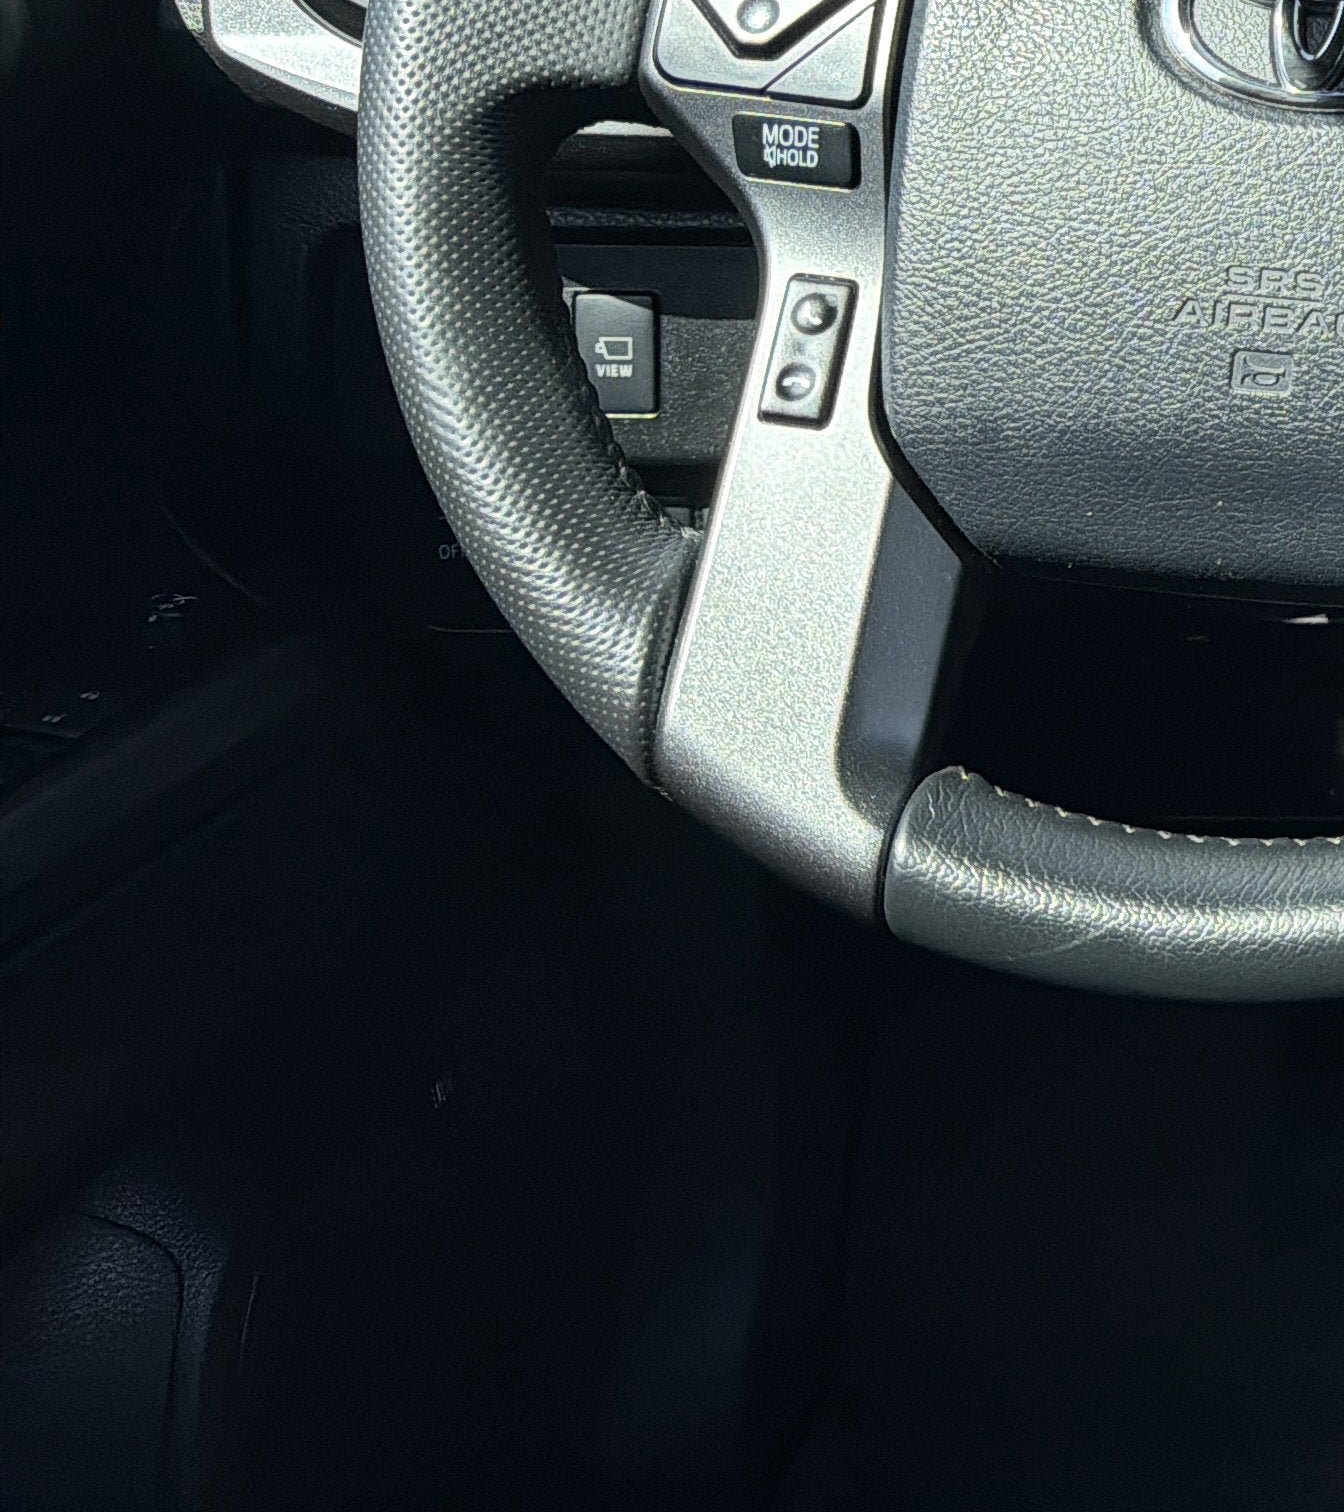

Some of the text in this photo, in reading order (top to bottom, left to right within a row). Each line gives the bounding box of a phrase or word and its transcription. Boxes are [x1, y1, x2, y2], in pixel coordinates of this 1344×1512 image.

[762, 123, 821, 149] MODE
[776, 149, 819, 168] HOLD
[1226, 265, 1323, 296] SRS
[595, 363, 634, 378] VIEW
